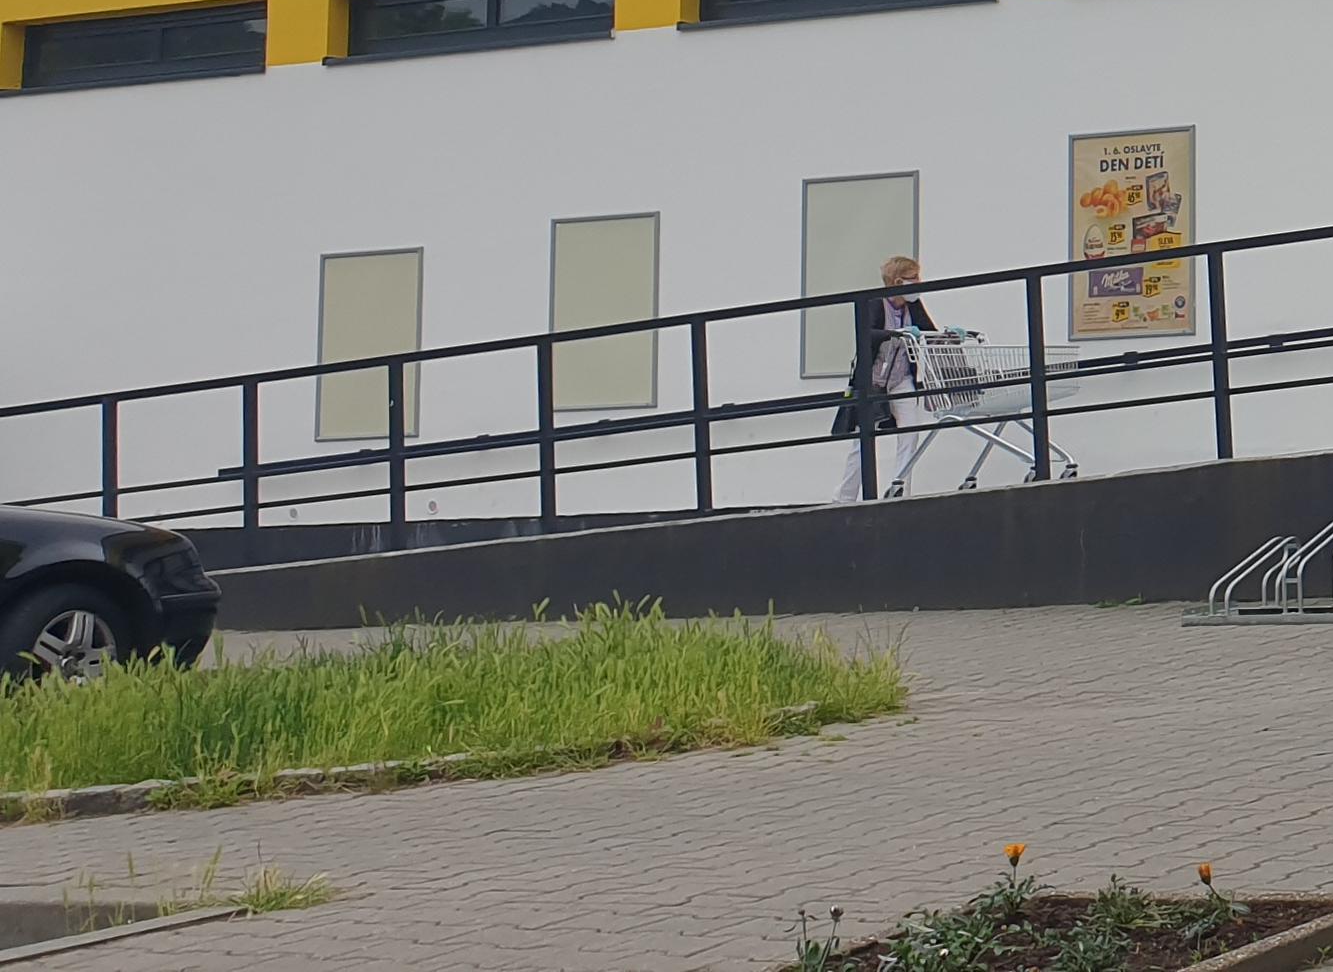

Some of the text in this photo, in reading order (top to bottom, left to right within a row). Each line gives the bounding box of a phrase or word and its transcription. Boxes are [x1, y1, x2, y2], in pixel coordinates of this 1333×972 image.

[1123, 143, 1161, 154] OSLAVTE
[1100, 151, 1165, 172] DEN DĚTÍ
